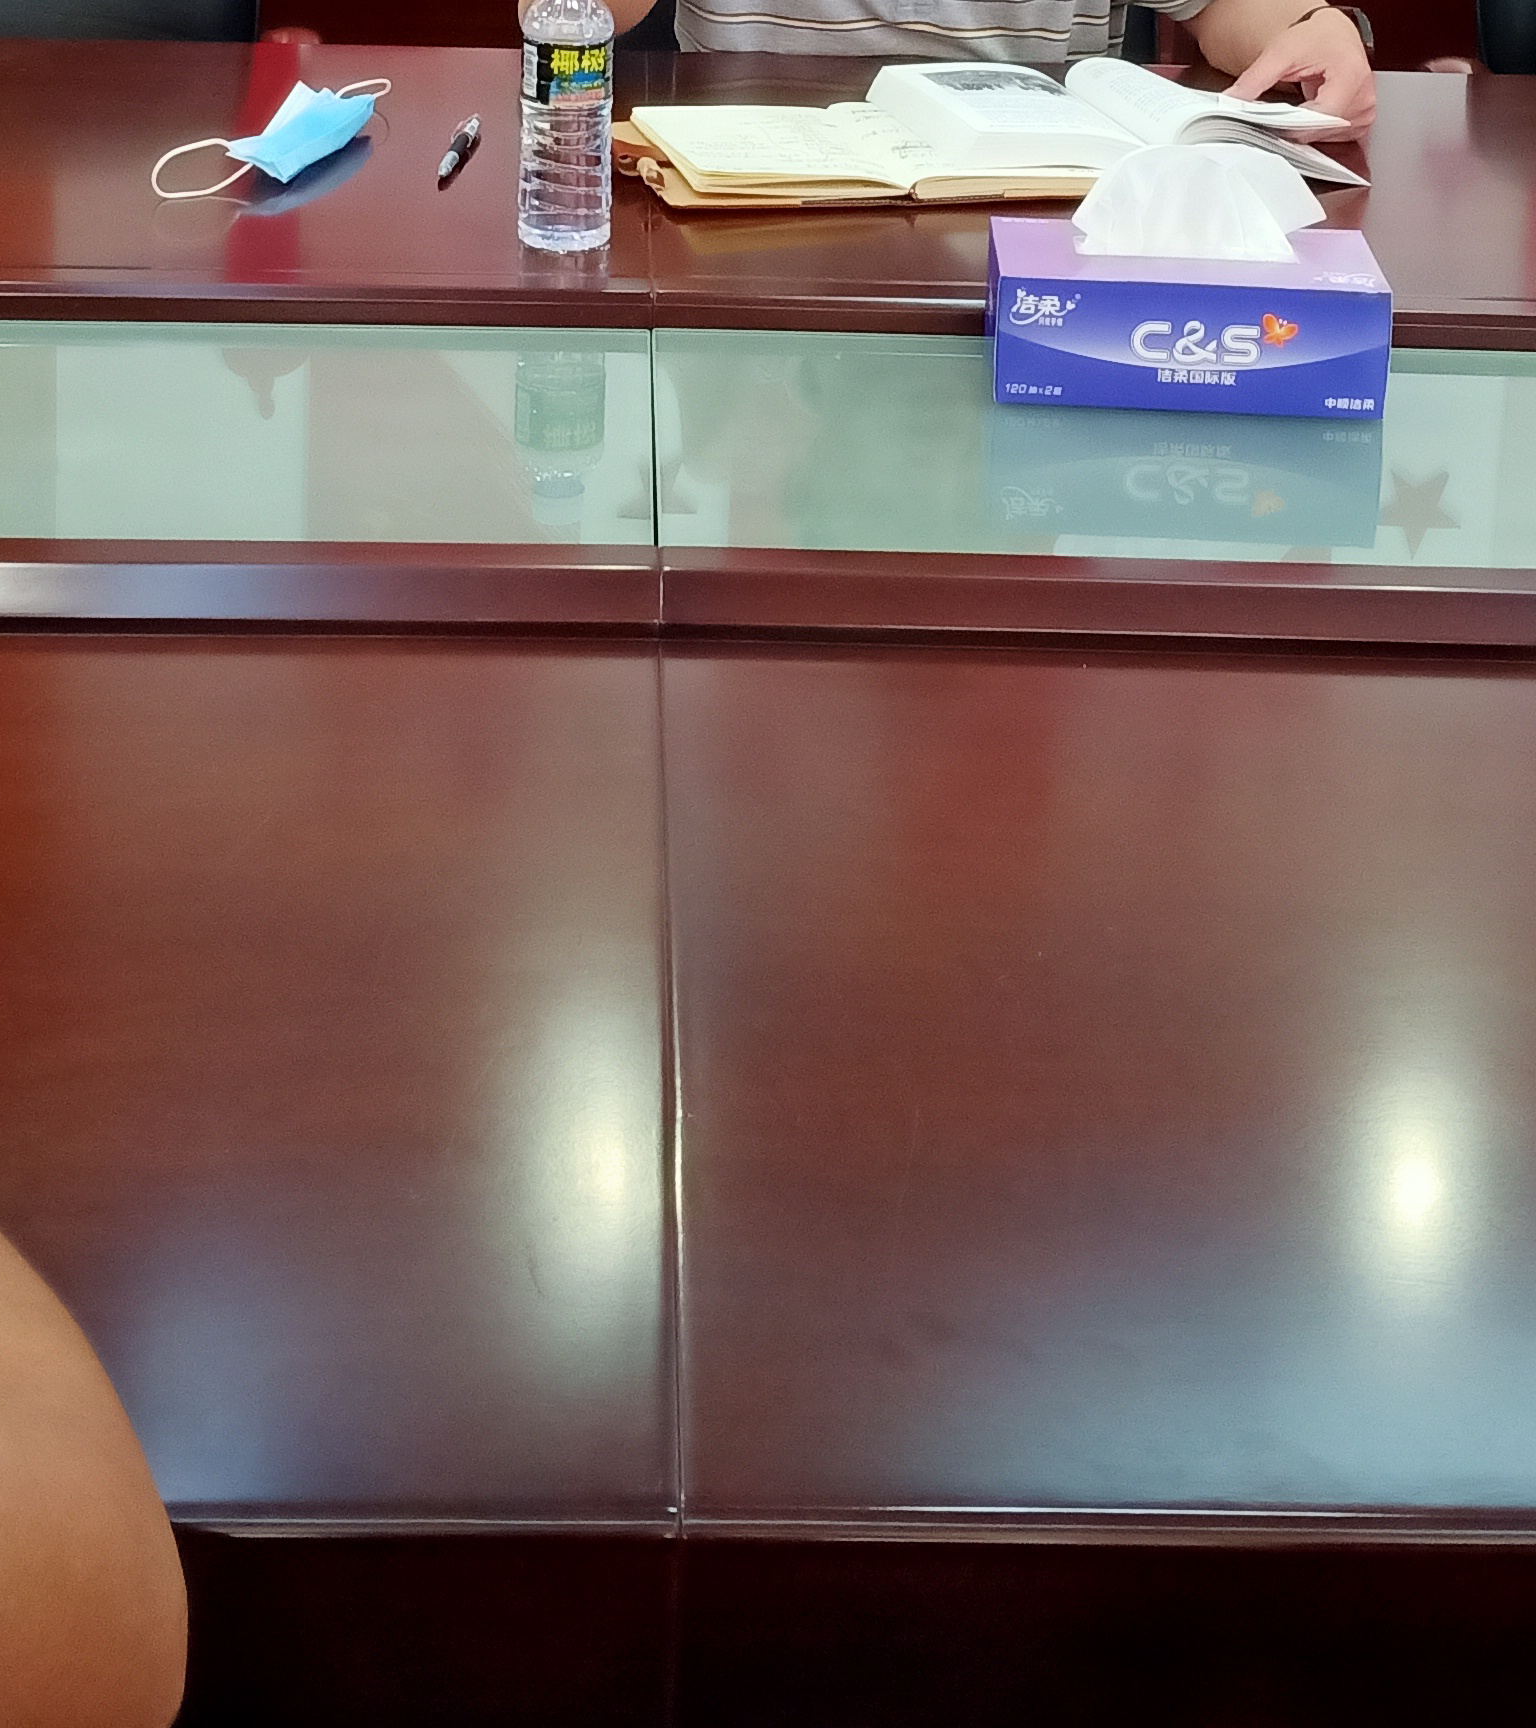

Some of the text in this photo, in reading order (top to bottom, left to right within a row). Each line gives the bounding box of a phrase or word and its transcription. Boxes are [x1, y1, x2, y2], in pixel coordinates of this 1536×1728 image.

[550, 47, 606, 75] 椰树
[1010, 289, 1062, 315] 洁柔
[1130, 319, 1265, 366] C&S
[1157, 368, 1237, 387] 洁柔国际版
